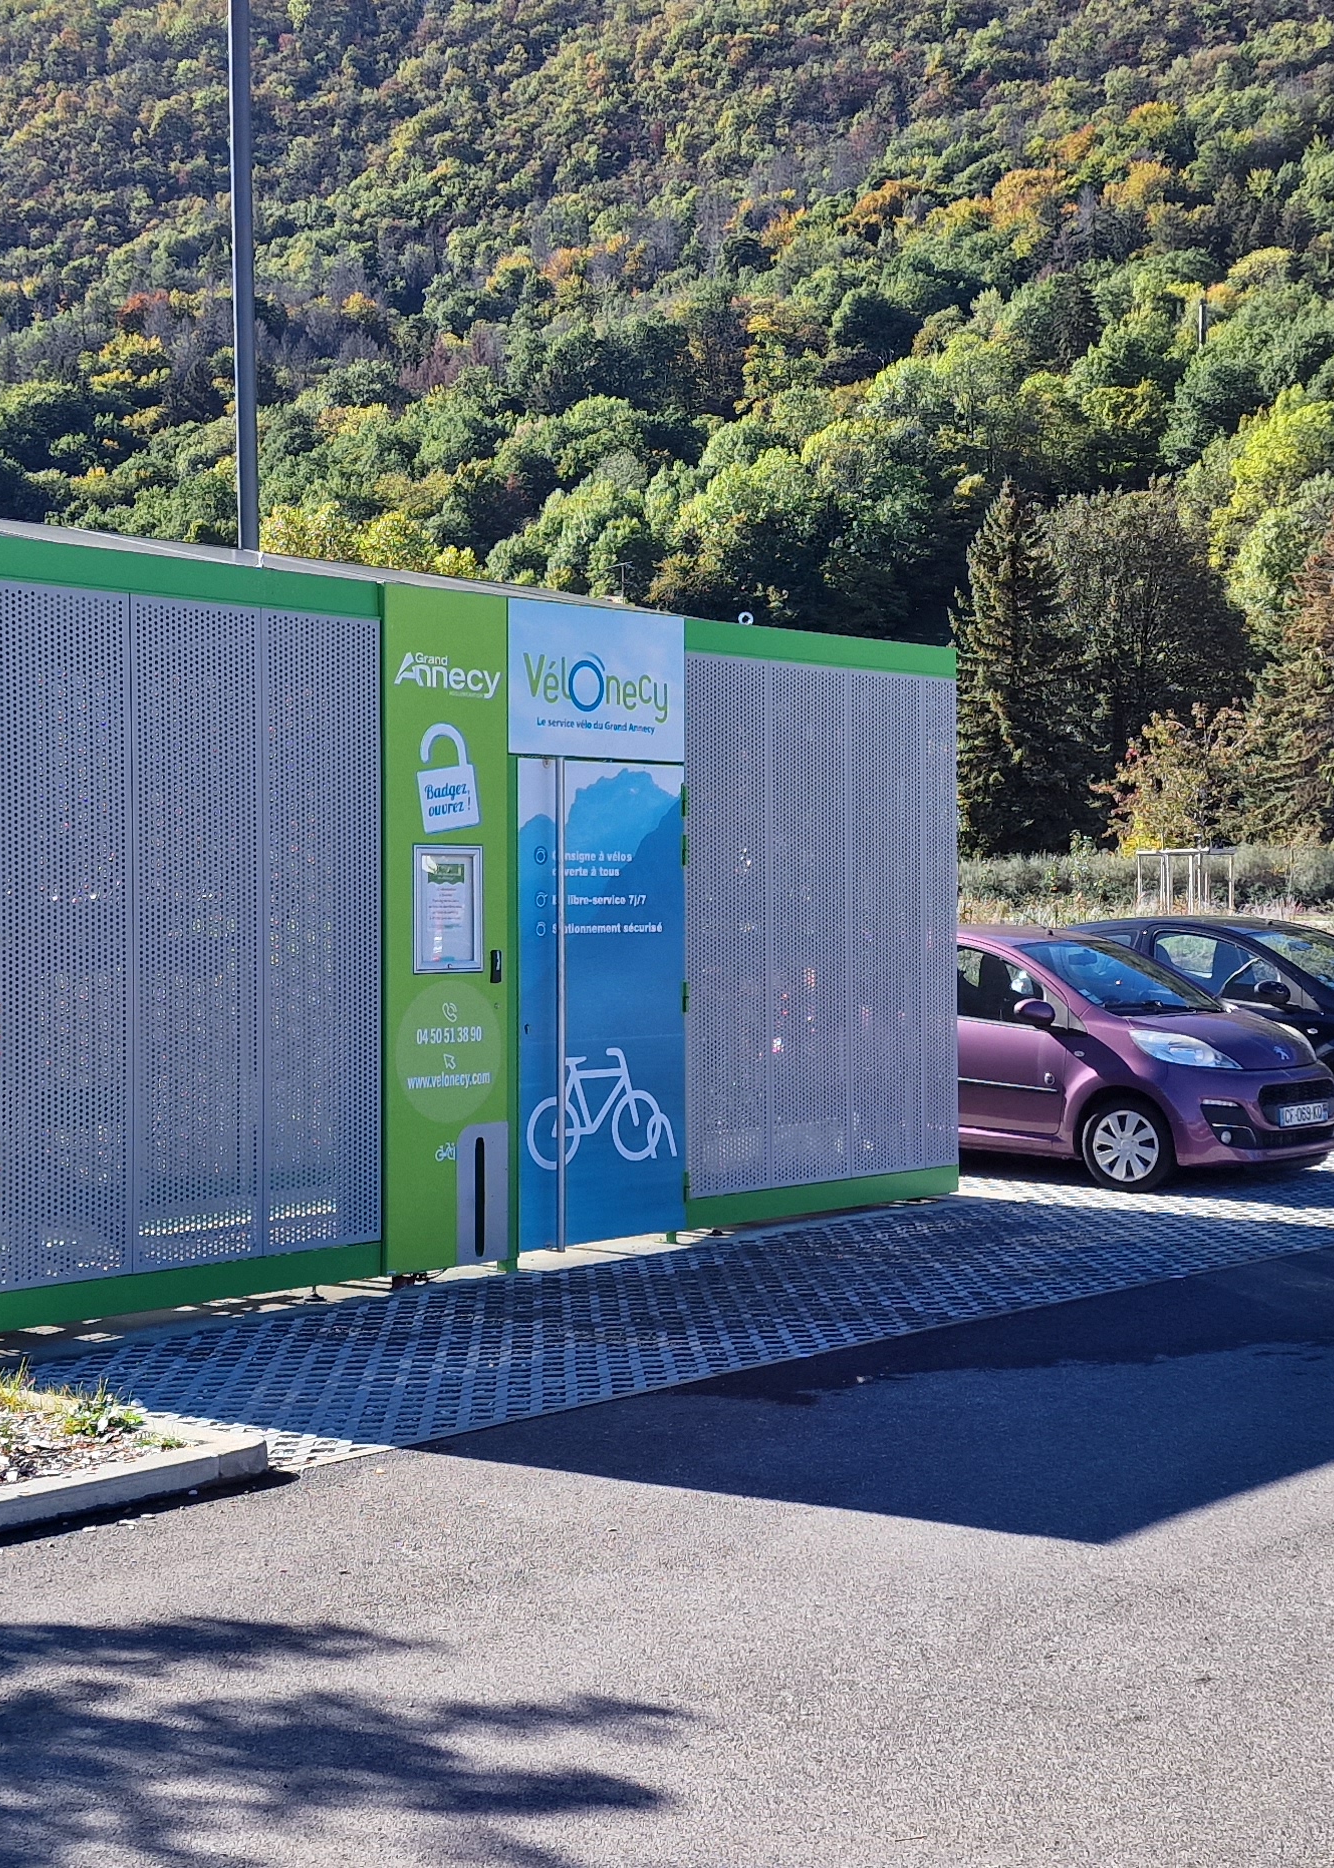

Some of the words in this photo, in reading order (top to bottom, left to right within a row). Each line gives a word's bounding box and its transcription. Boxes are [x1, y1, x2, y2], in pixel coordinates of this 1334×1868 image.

[415, 652, 448, 665] Grand
[394, 651, 501, 699] Annecy
[536, 717, 546, 726] Le
[548, 719, 575, 729] service
[576, 719, 592, 730] vélo
[593, 721, 604, 730] du
[604, 721, 628, 732] Grand
[628, 723, 655, 735] Annecy
[424, 782, 470, 801] Badgez,
[428, 801, 464, 817] ouvrez
[552, 850, 596, 864] Cnsigne
[598, 850, 605, 862] à
[607, 851, 633, 862] vélos
[552, 867, 588, 877] overte
[590, 865, 597, 877] à
[599, 867, 620, 877] tous
[567, 894, 627, 906] libre-service
[628, 894, 647, 907] 7j/7
[623, 921, 663, 934] sécurisé
[416, 1028, 429, 1045] 04
[430, 1027, 443, 1044] 50
[443, 1027, 456, 1044] 51
[457, 1026, 469, 1043] 38
[470, 1025, 482, 1042] 90
[407, 1071, 491, 1090] www.velonecy.com
